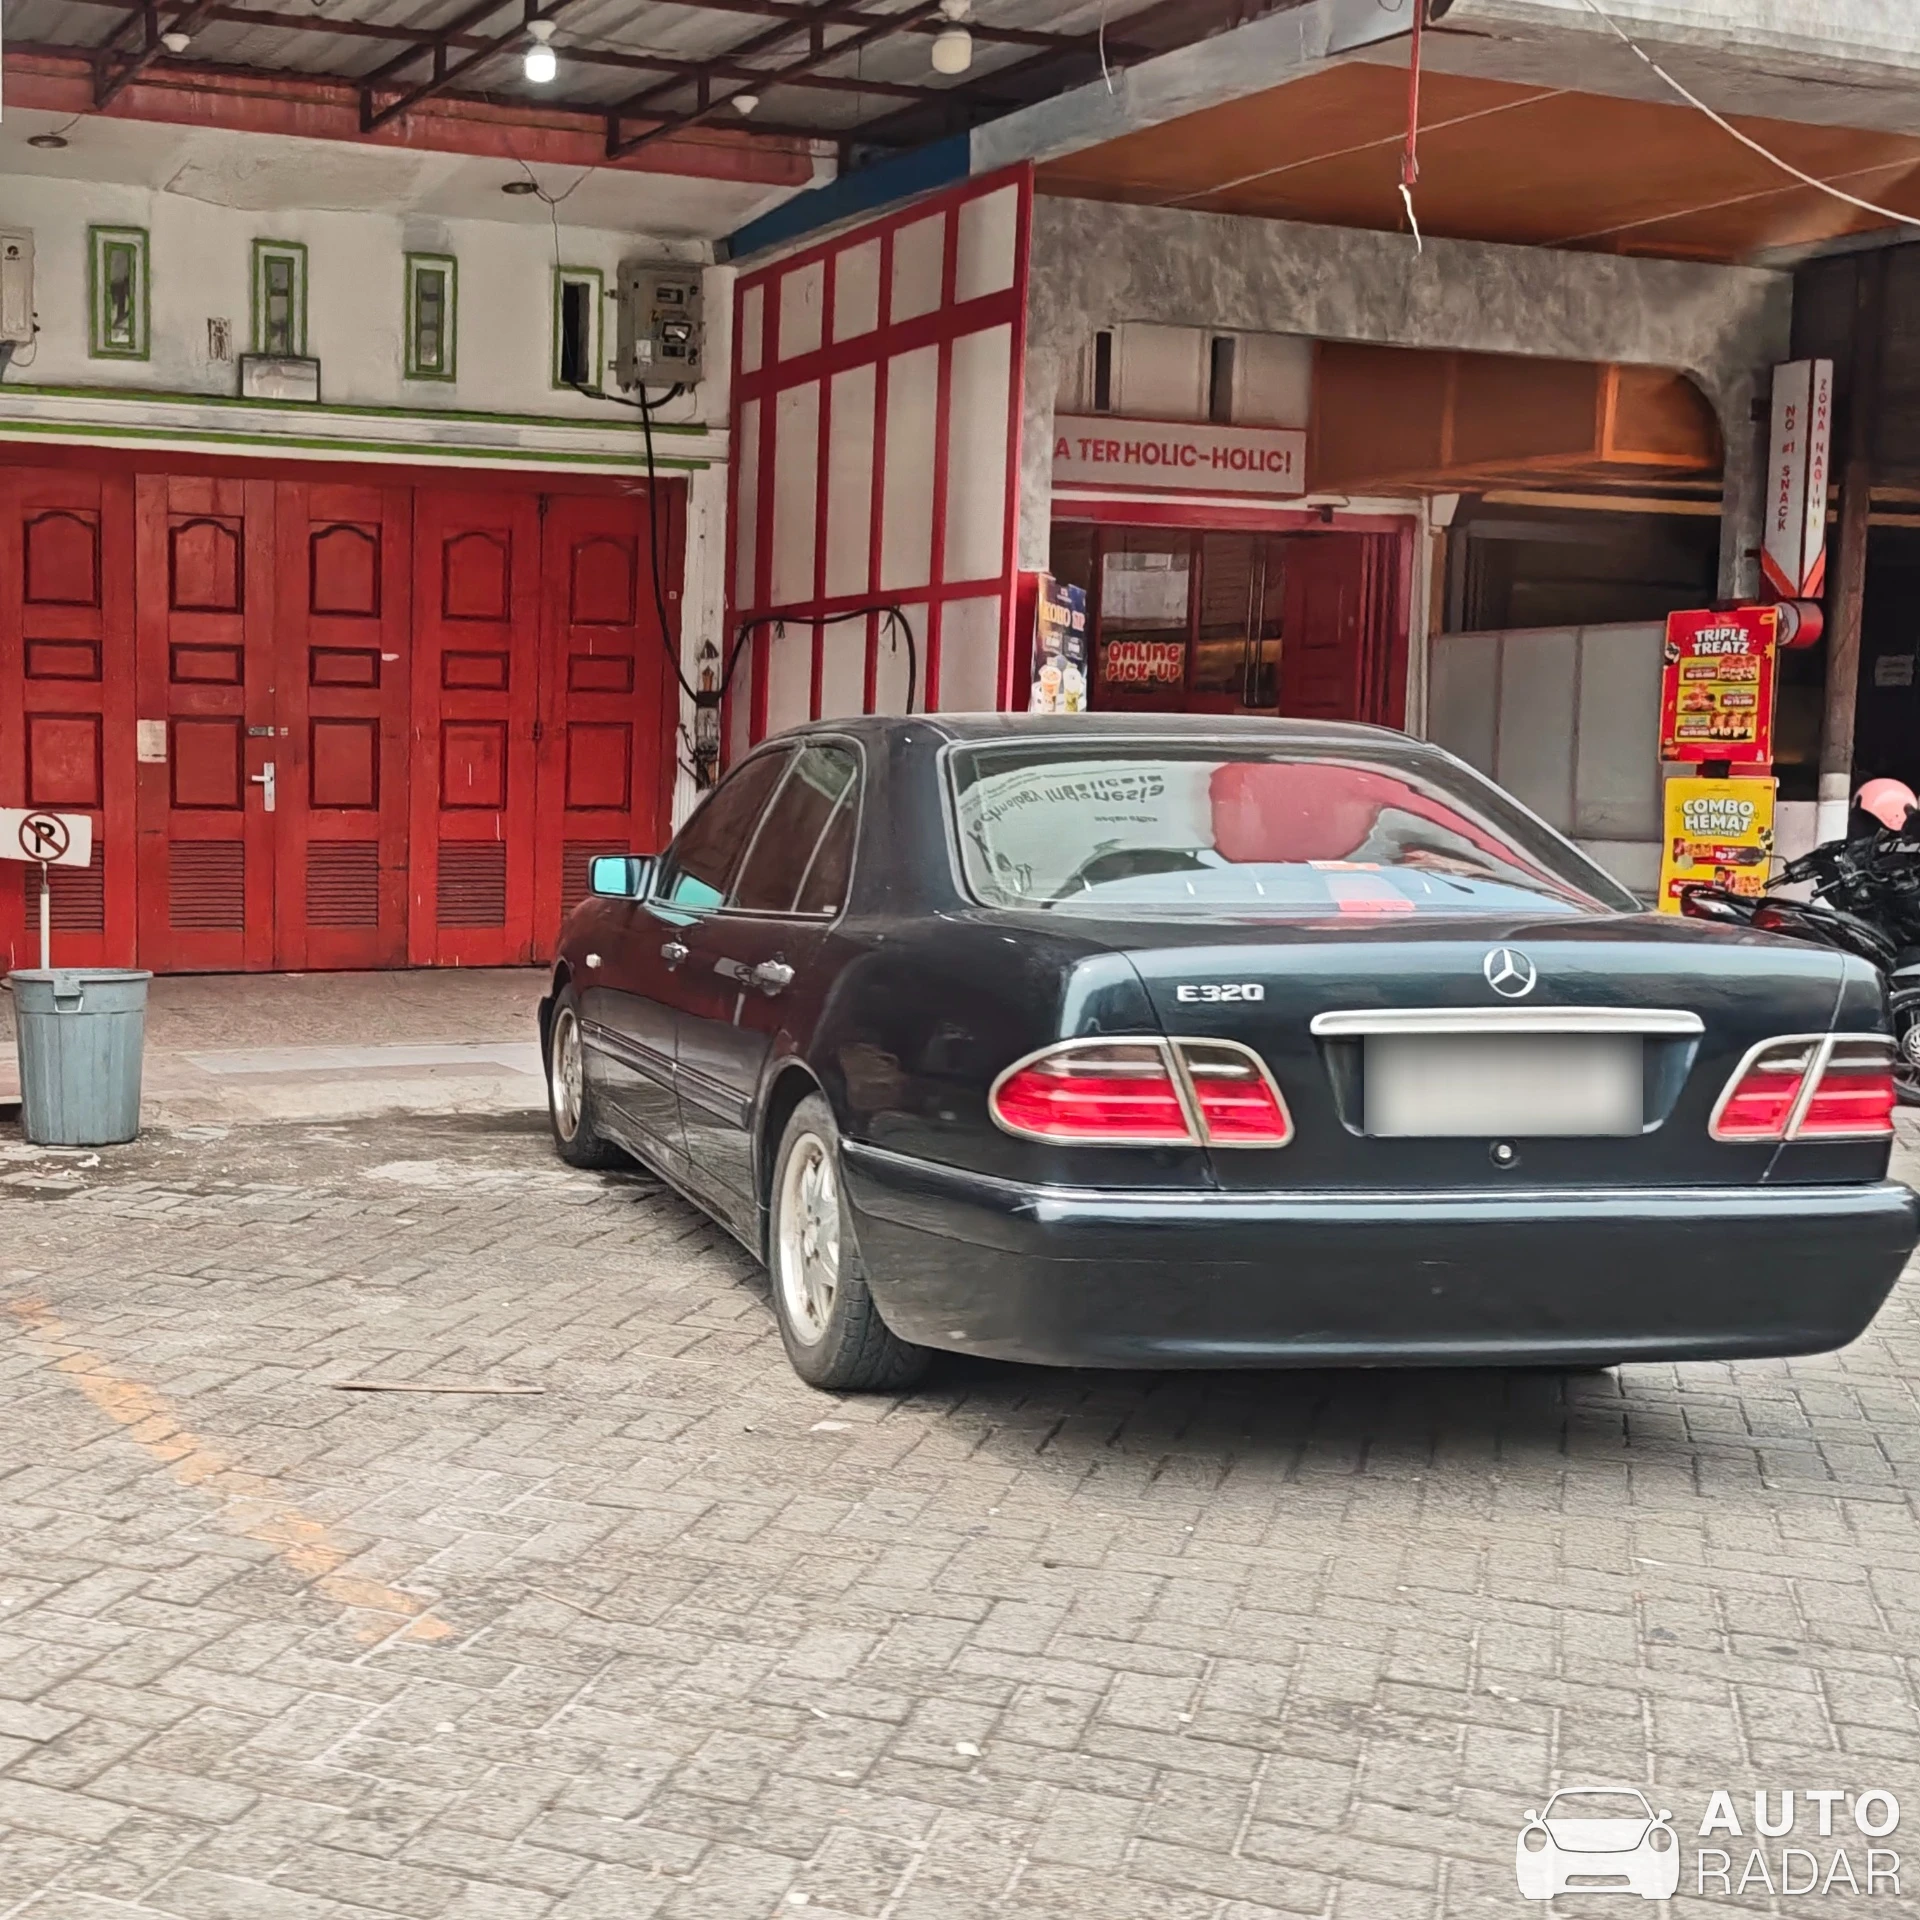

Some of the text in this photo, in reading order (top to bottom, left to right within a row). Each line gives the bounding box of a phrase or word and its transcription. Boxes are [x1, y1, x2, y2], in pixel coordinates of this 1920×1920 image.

[1816, 378, 1828, 431] ZONA
[1784, 403, 1797, 431] NO
[1812, 442, 1824, 509] NAGIH
[1777, 464, 1791, 532] SNACK
[1694, 628, 1750, 643] TRIPLE
[1691, 641, 1750, 656] TREATZ
[1106, 662, 1181, 683] PICK-UP
[1682, 798, 1755, 817] COMBO
[1684, 814, 1752, 832] HEMAT
[35, 821, 56, 853] P
[1176, 983, 1265, 1002] E320
